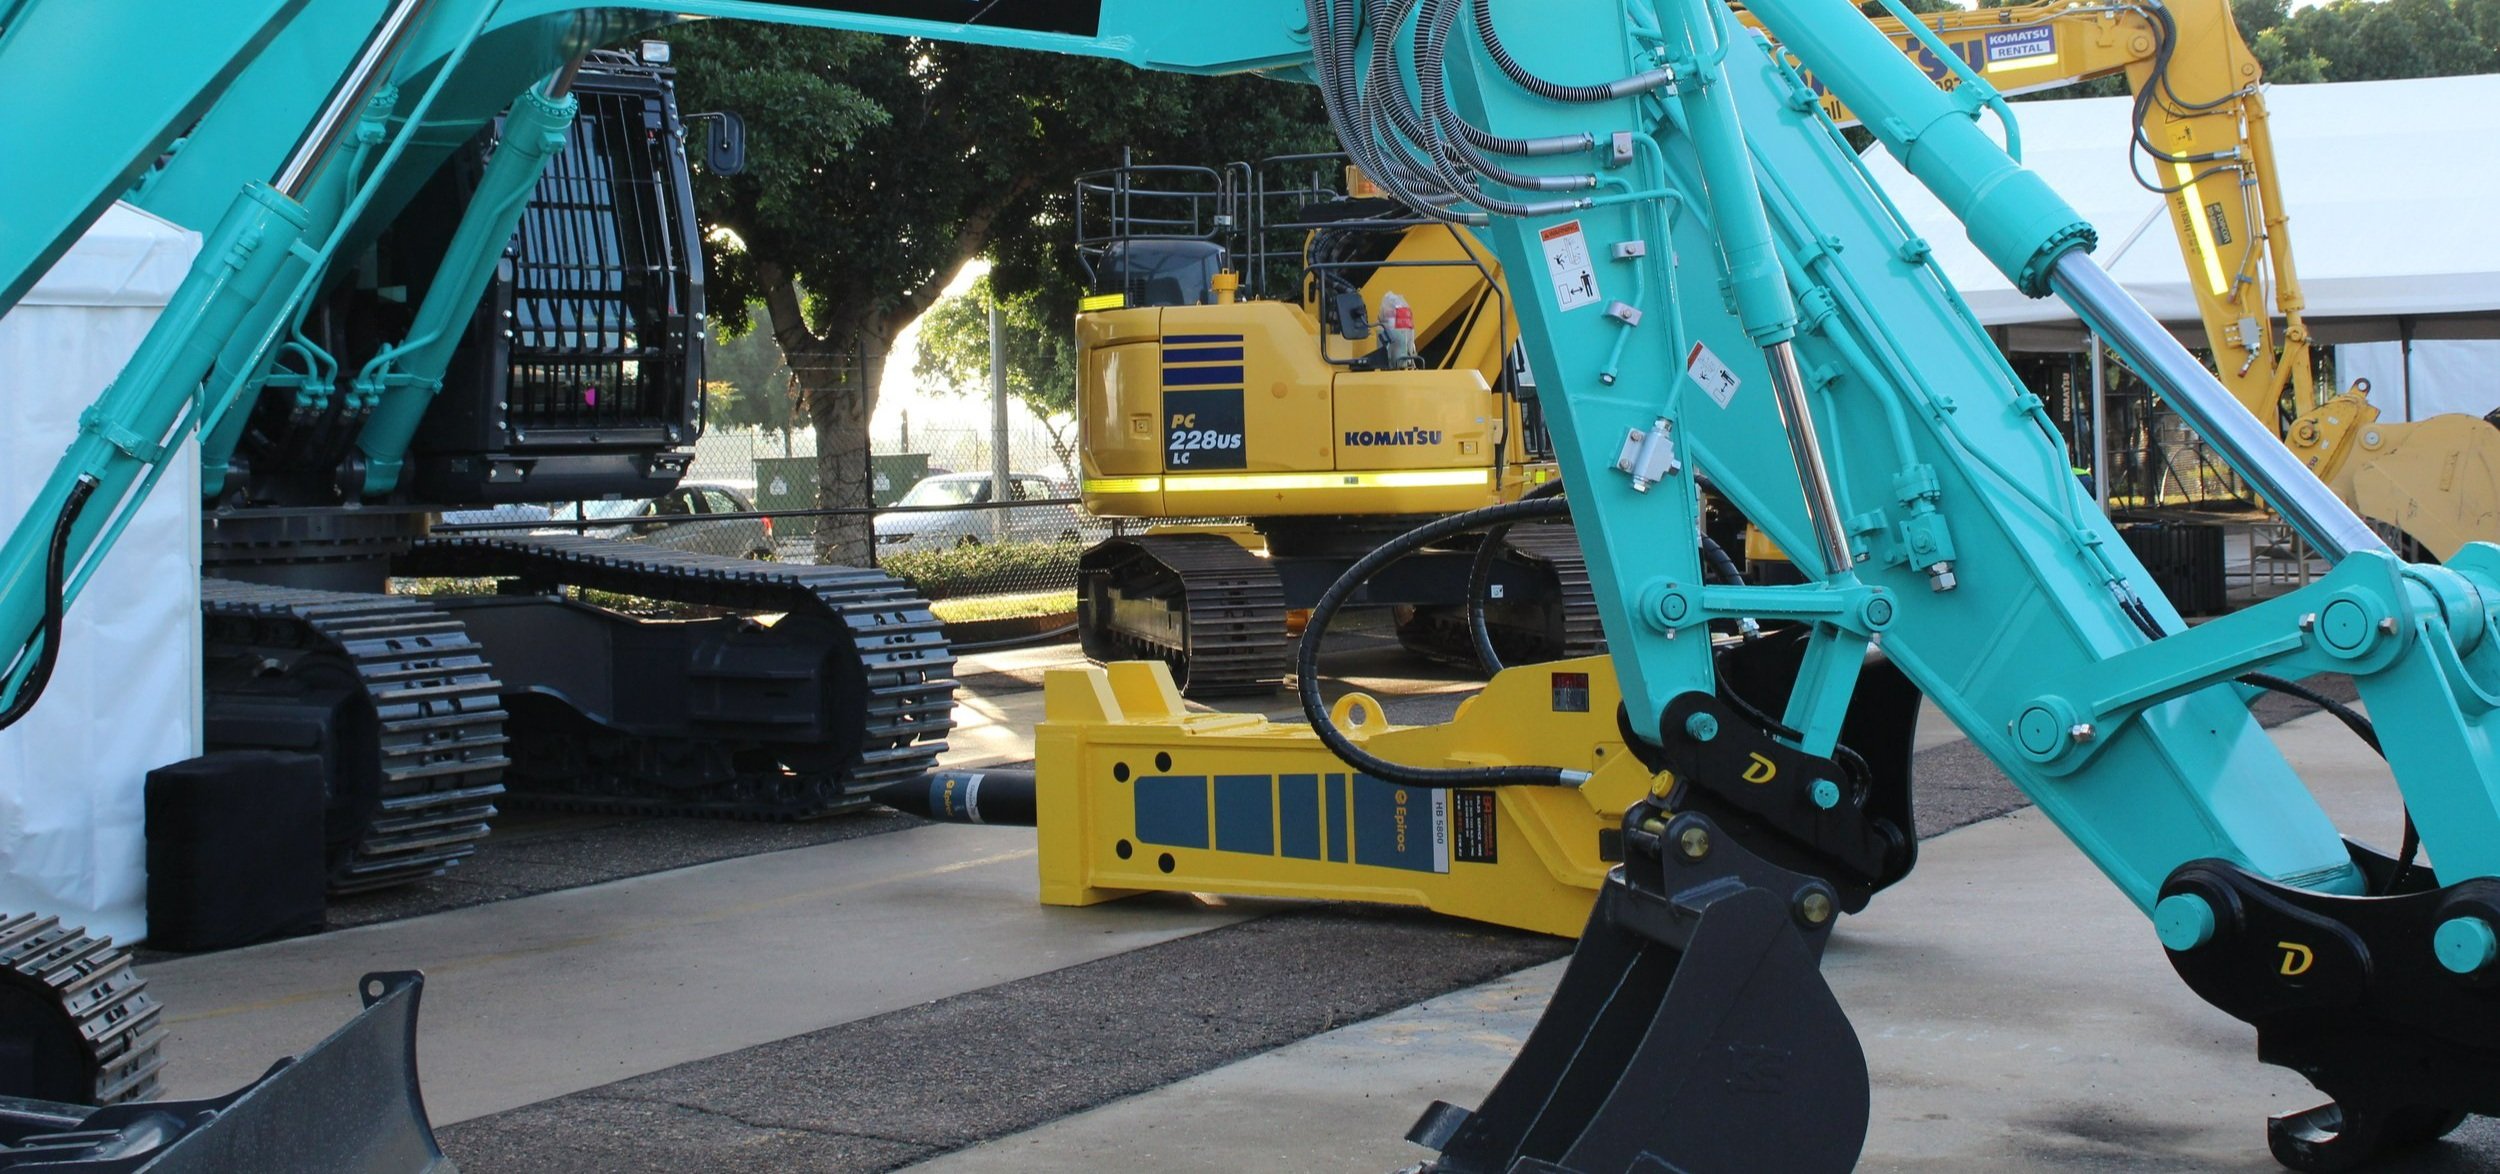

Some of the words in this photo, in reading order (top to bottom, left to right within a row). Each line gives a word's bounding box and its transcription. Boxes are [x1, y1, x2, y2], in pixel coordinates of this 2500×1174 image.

[1989, 28, 2049, 45] KOMATSU
[1998, 44, 2043, 57] RENTAL
[2062, 373, 2070, 421] KOMATSU
[1171, 413, 1196, 429] PC
[1169, 429, 1242, 450] 228US
[1344, 426, 1442, 447] KOMATSU
[1172, 452, 1190, 465] LC
[1435, 801, 1444, 817] HB
[1394, 807, 1407, 852] Epiroc
[1436, 820, 1444, 845] 5800
